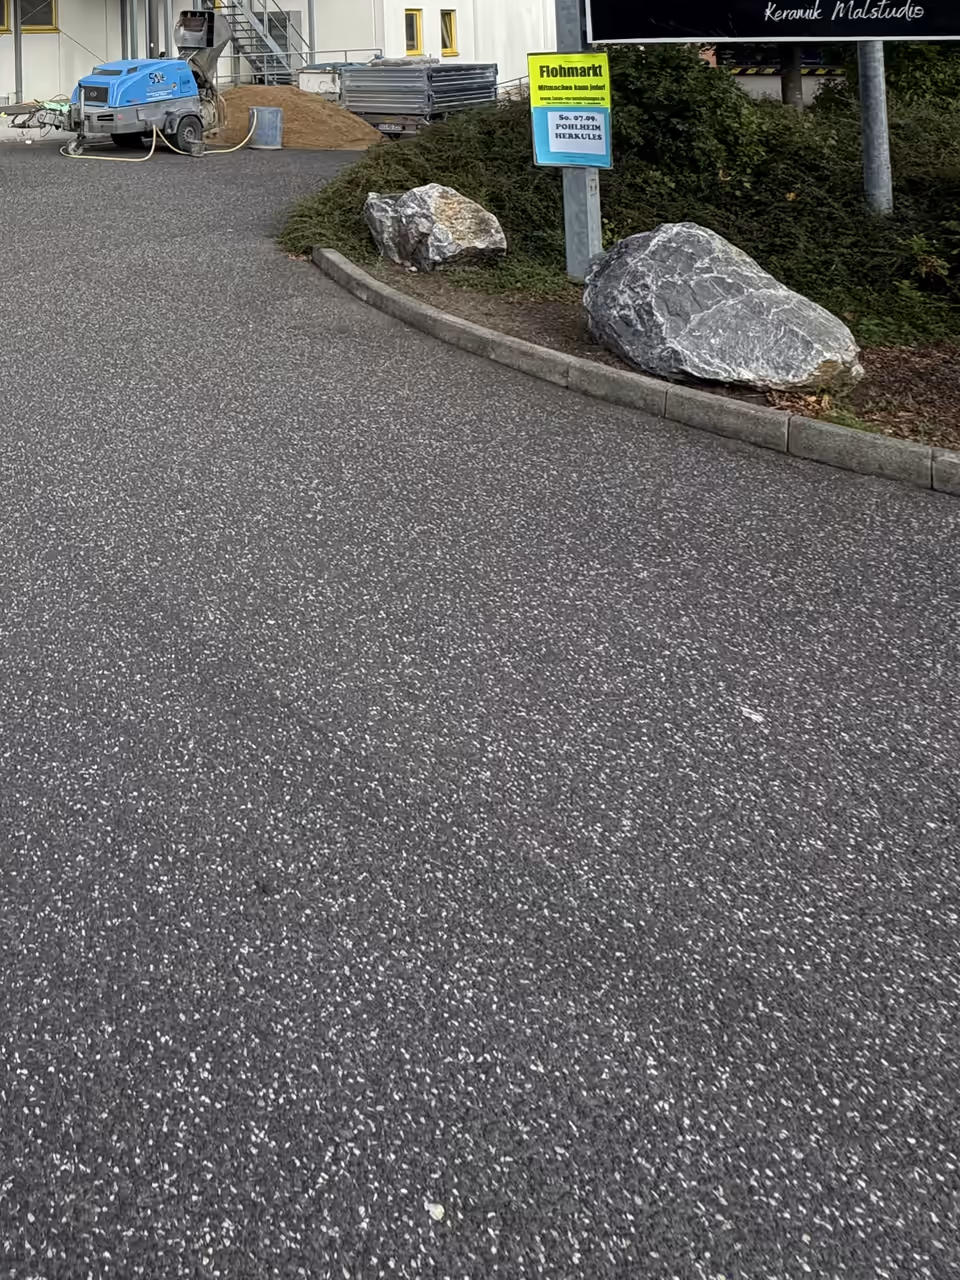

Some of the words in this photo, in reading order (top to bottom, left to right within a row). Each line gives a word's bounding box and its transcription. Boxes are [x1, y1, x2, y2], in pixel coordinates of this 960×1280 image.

[539, 63, 604, 79] Flohmarkt
[555, 123, 602, 131] POHLHEIM
[554, 132, 603, 141] HERKULES
